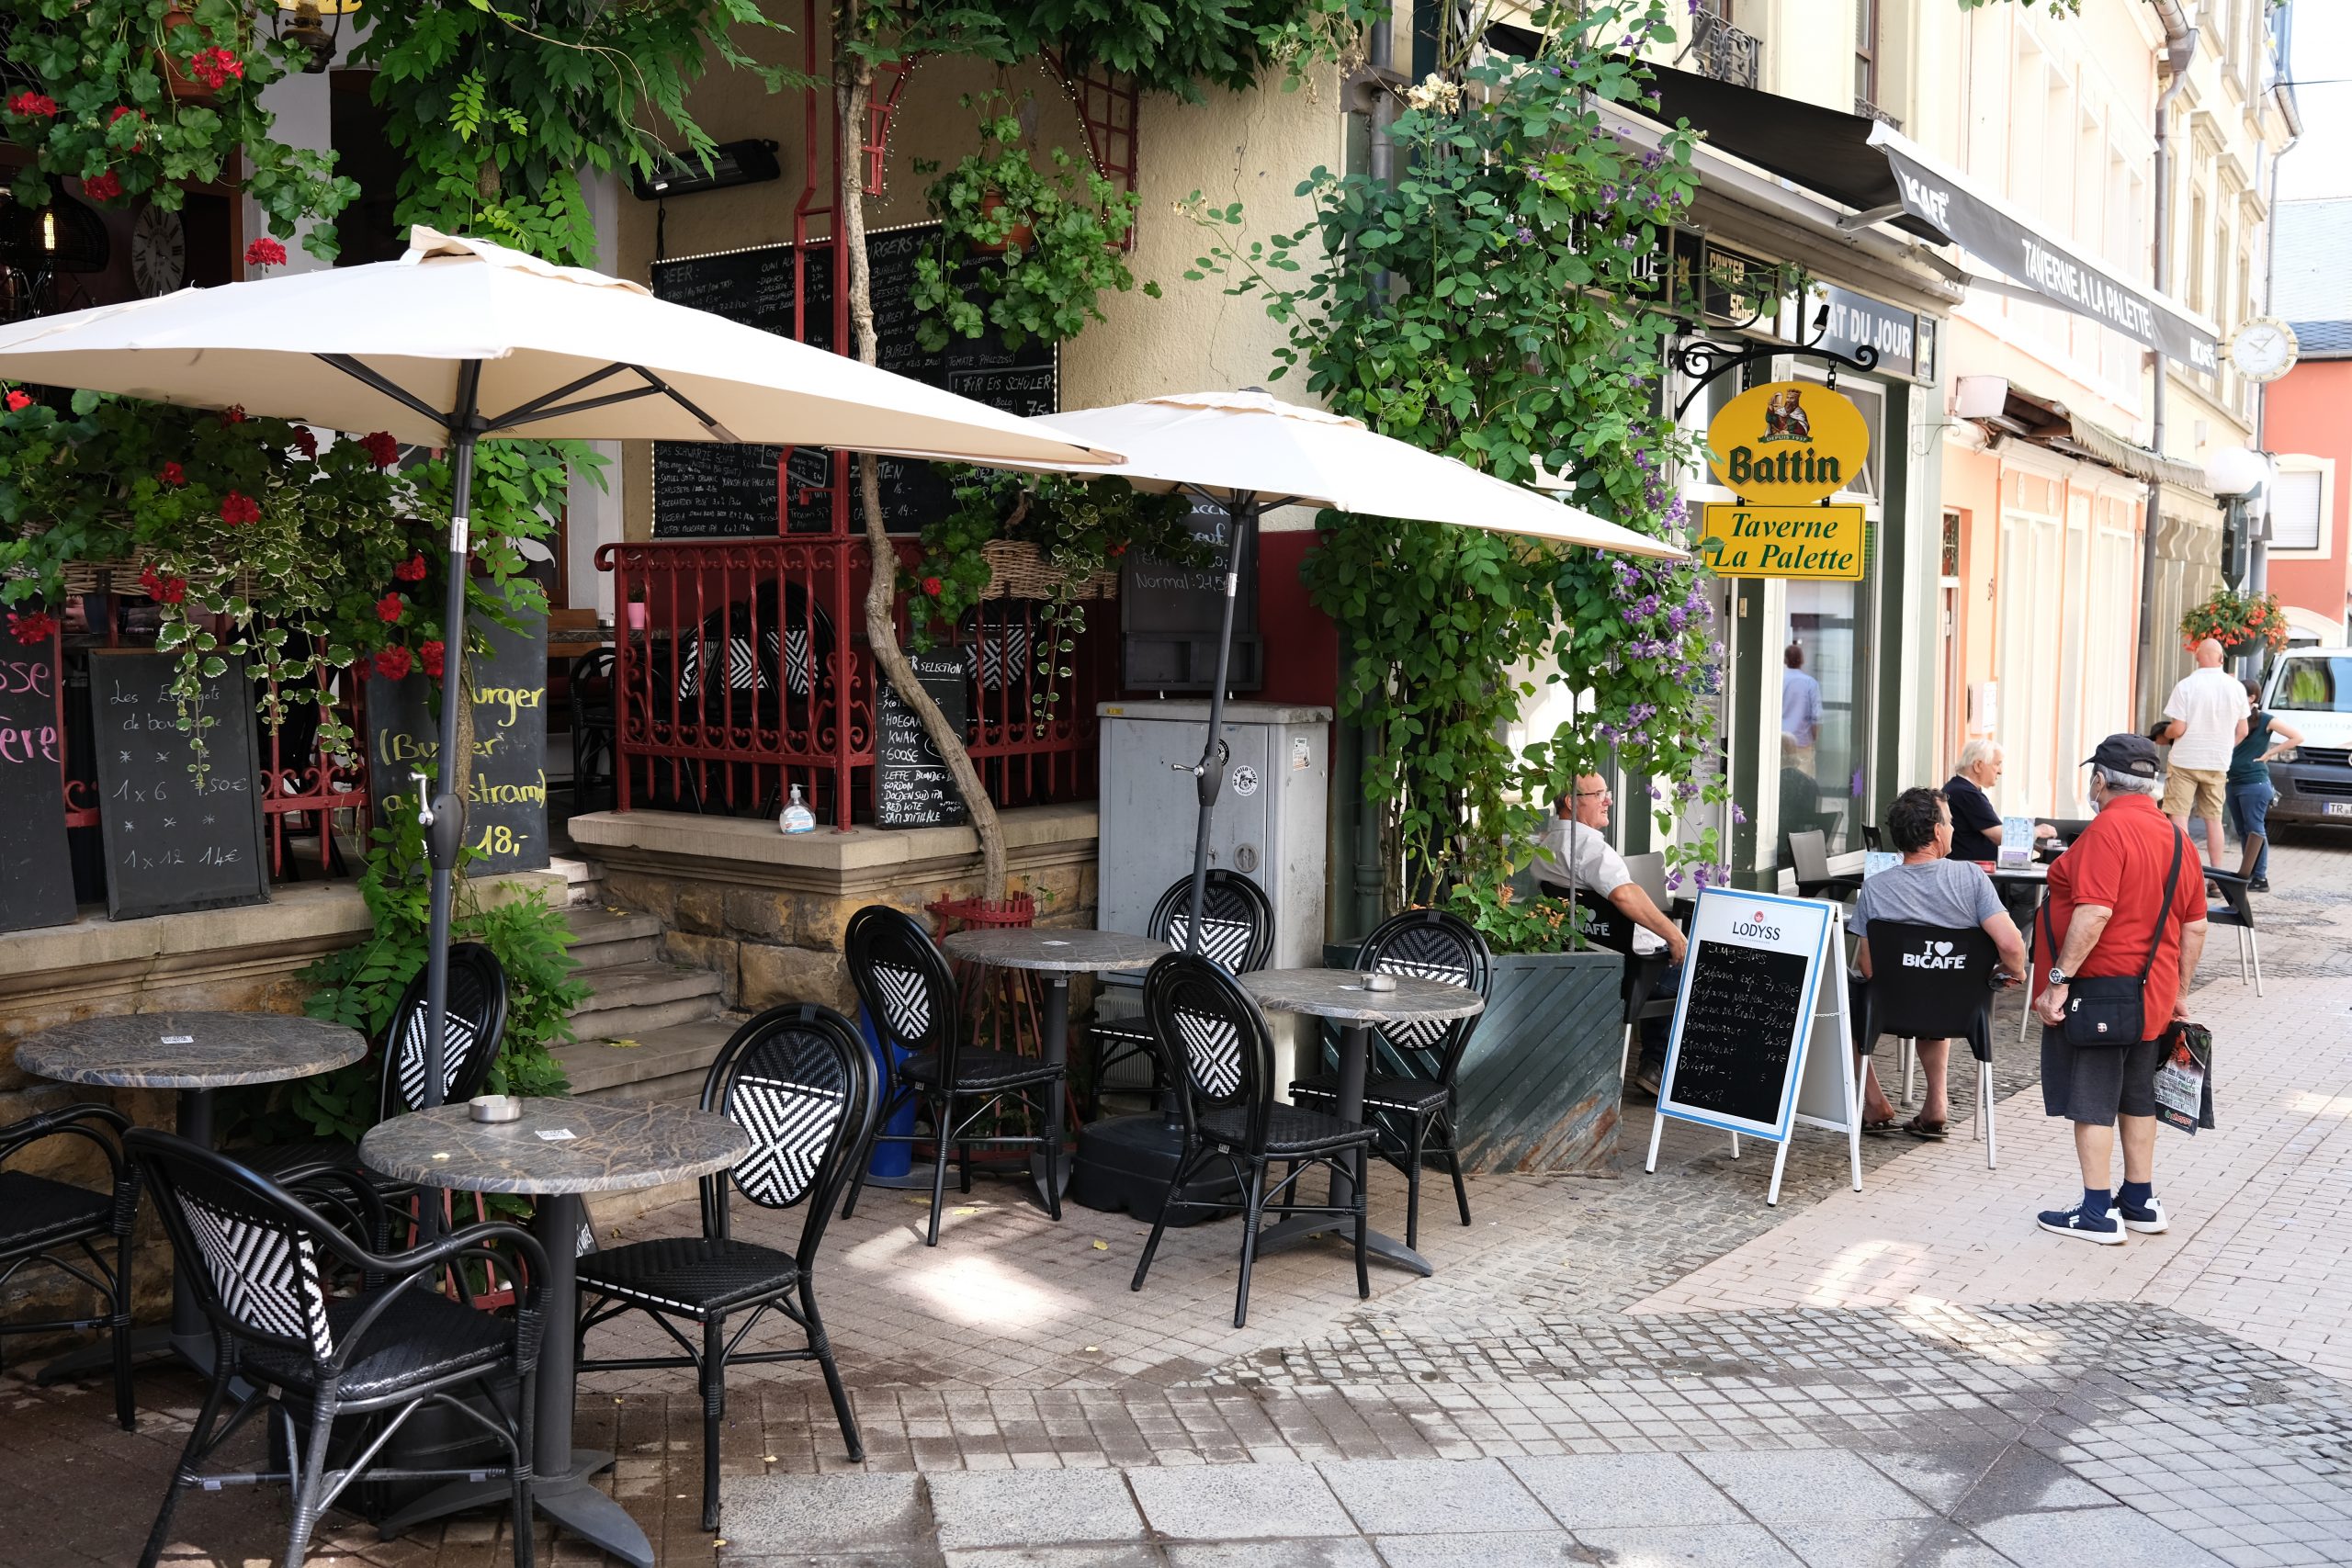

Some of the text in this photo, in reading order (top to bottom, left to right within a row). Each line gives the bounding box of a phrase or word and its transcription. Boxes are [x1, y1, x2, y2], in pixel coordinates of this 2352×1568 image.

[2021, 238, 2153, 341] TAVERNE A LA PALETTE
[1849, 308, 1871, 346] DU
[1873, 317, 1912, 360] JOUR
[1727, 446, 1842, 486] Battin
[1730, 513, 1838, 539] Taverne
[1713, 543, 1853, 571] La Palette
[110, 679, 140, 706] Les
[122, 712, 141, 732] de
[888, 728, 919, 745] KWAK
[886, 748, 920, 763] GOOSE
[154, 780, 167, 801] 6
[886, 801, 902, 813] RED
[2330, 803, 2343, 814] TR
[478, 825, 530, 857] 18,-
[198, 845, 243, 864] 14€
[1732, 920, 1781, 942] LODYSS
[1923, 940, 1934, 956] I
[1902, 953, 1968, 970] BICAFÉ
